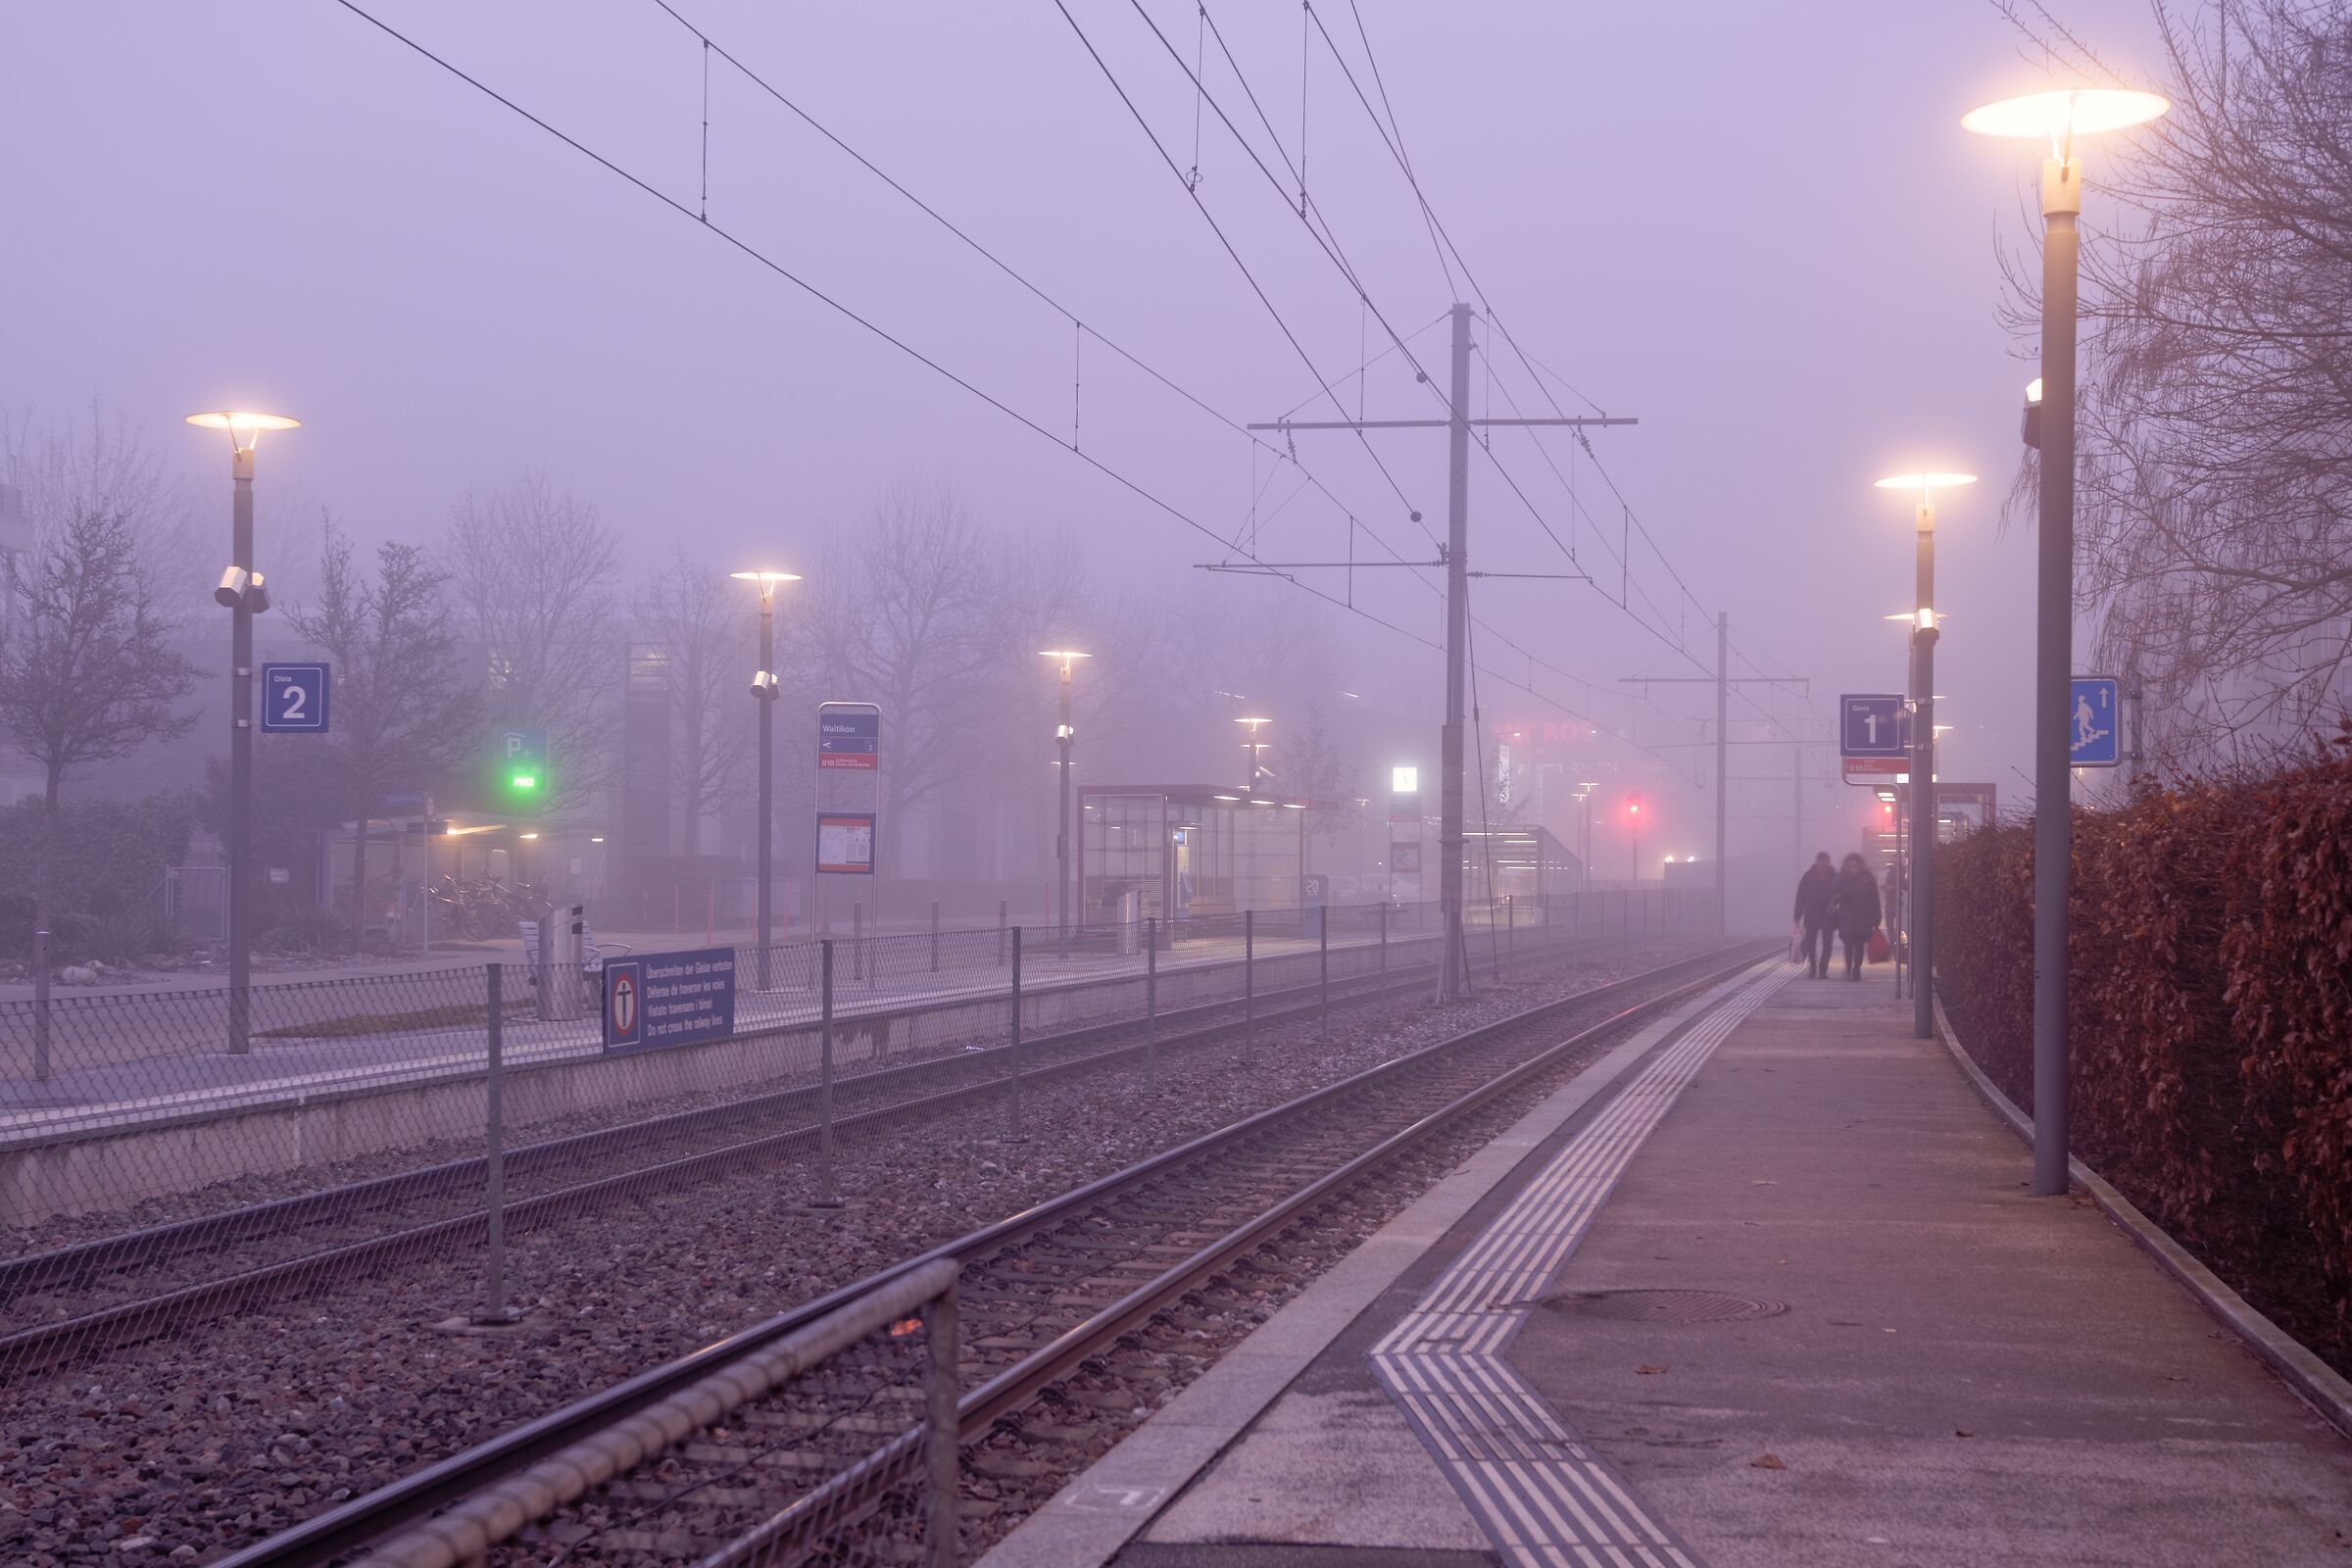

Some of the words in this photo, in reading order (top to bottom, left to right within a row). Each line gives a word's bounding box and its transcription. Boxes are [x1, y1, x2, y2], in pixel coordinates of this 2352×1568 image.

[283, 685, 306, 719] 2
[822, 724, 856, 733] Waltikon
[1864, 714, 1876, 744] 1
[685, 964, 694, 975] der
[695, 961, 710, 974] Gleise
[670, 983, 678, 996] de
[679, 982, 703, 995] traverser
[711, 978, 725, 990] voies
[668, 1002, 695, 1014] traversare
[647, 1024, 657, 1036] Do
[657, 1022, 666, 1035] not
[667, 1022, 683, 1033] cross
[684, 1019, 693, 1031] the
[693, 1016, 710, 1030] railway
[711, 1014, 723, 1026] lines
